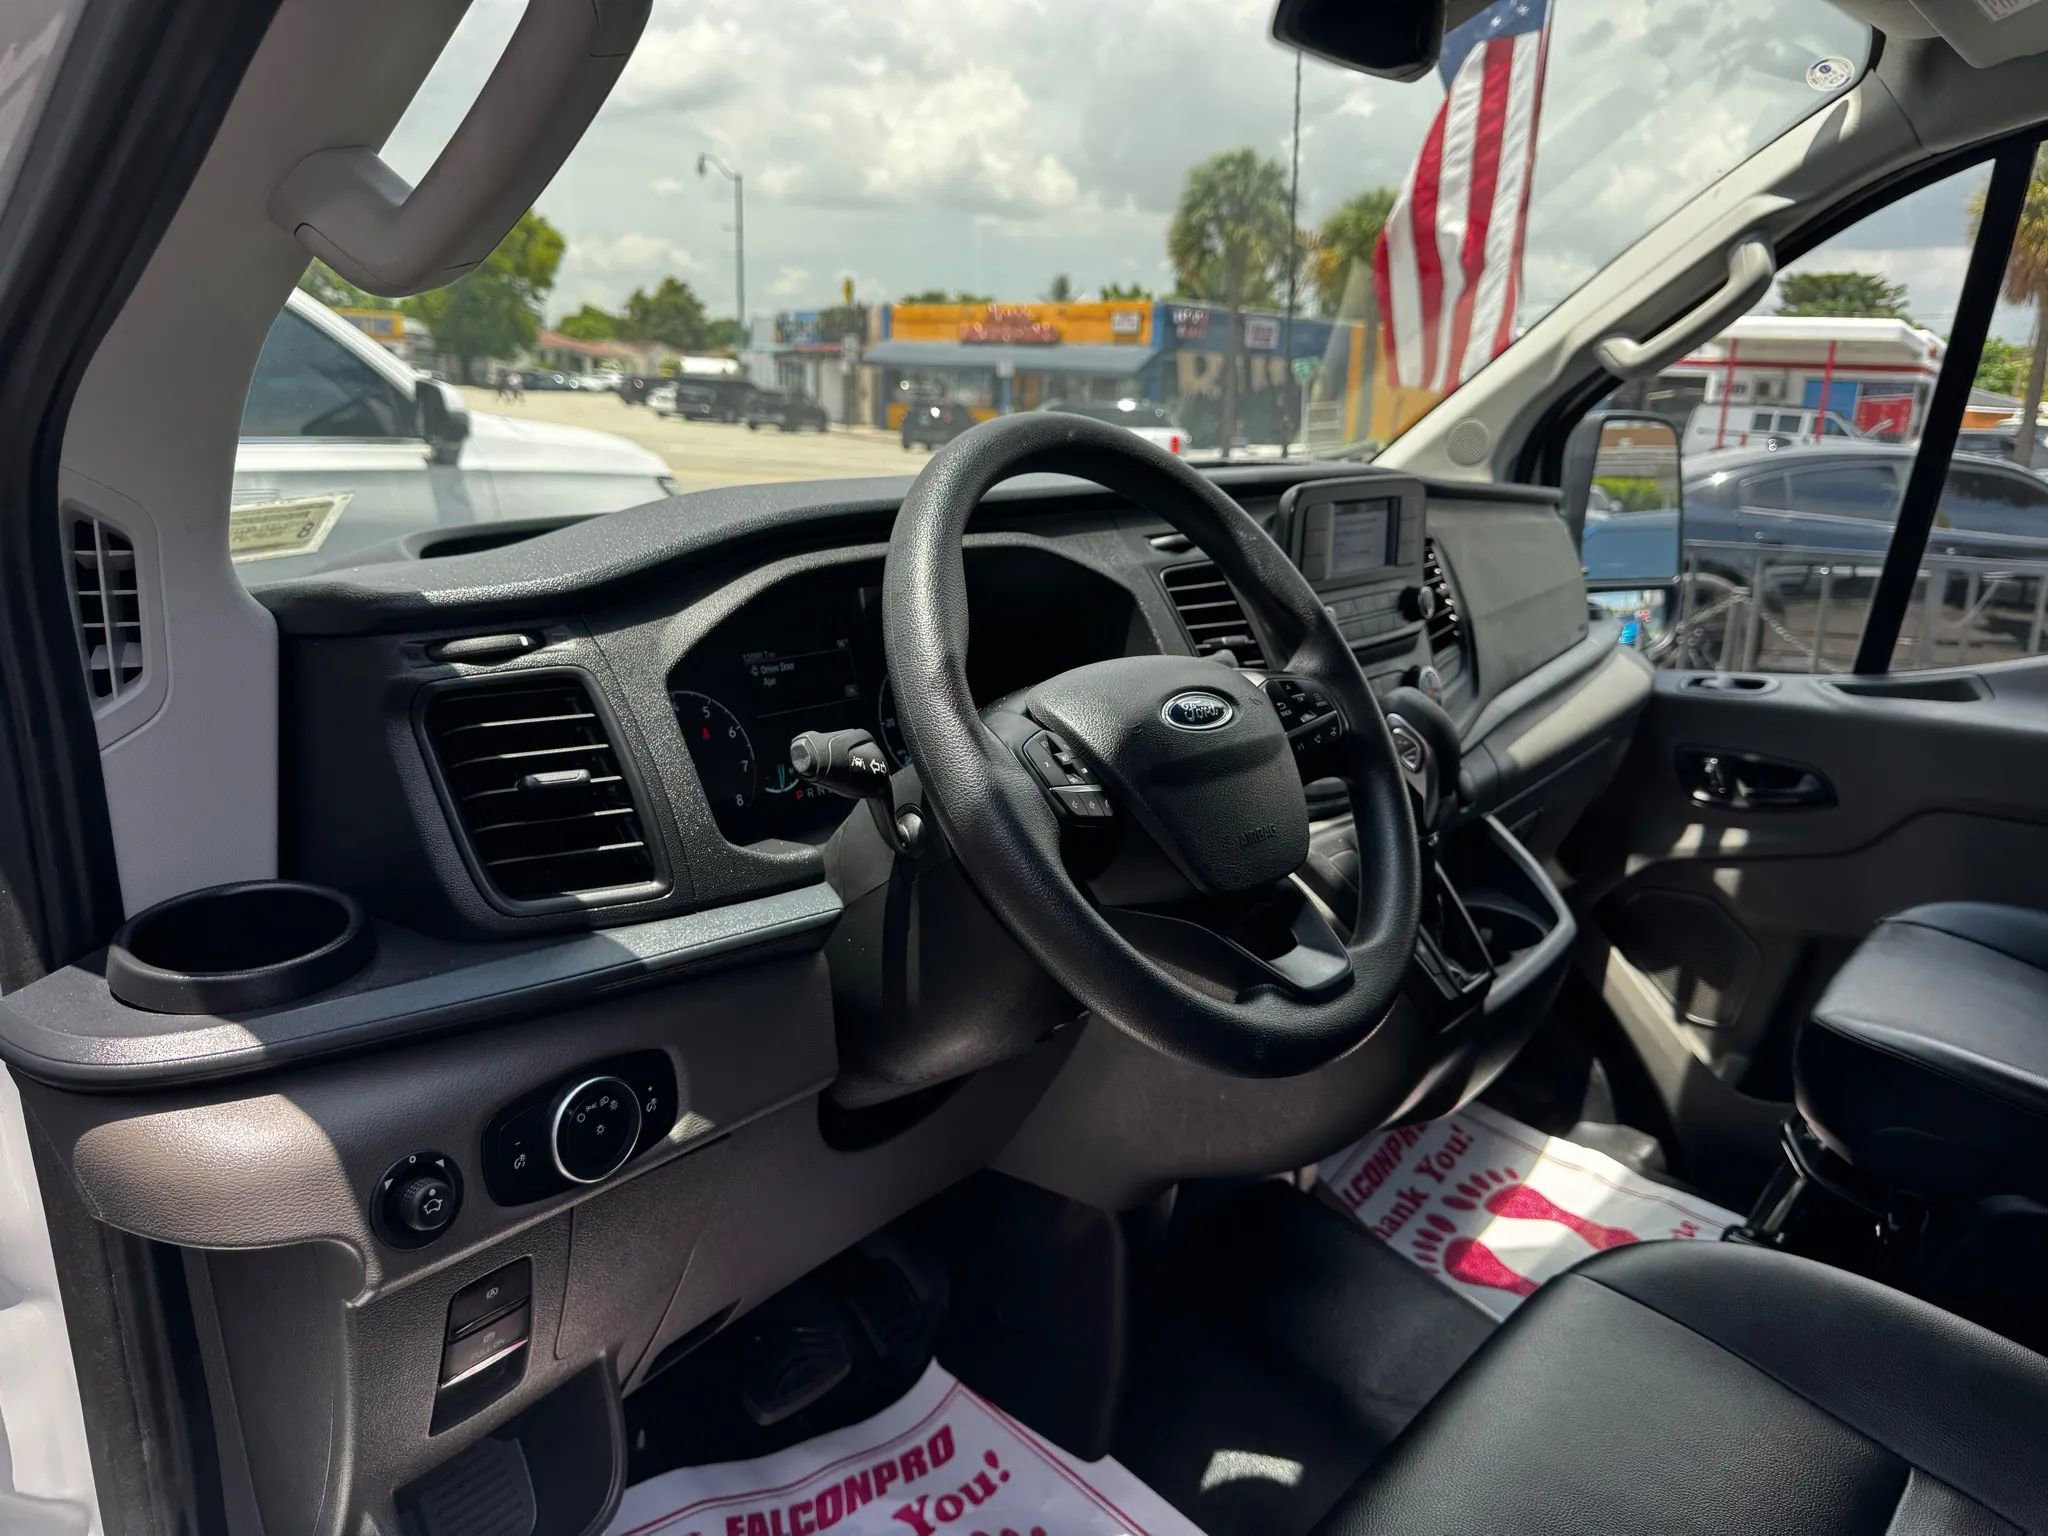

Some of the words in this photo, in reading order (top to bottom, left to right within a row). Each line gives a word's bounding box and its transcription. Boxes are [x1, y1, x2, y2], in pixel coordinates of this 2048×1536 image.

[297, 521, 315, 539] 8
[780, 661, 795, 672] Door
[702, 706, 711, 719] 5
[1180, 698, 1220, 722] Ford
[728, 725, 737, 739] 6
[740, 760, 749, 773] 7
[736, 794, 744, 807] 8
[795, 789, 804, 800] P
[807, 788, 815, 798] R
[1239, 823, 1277, 848] AIRBAG
[1413, 1123, 1475, 1184] You!
[1342, 1123, 1428, 1211] LCONPR
[726, 1424, 955, 1536] FALCONPRO
[892, 1449, 1010, 1536] You!
